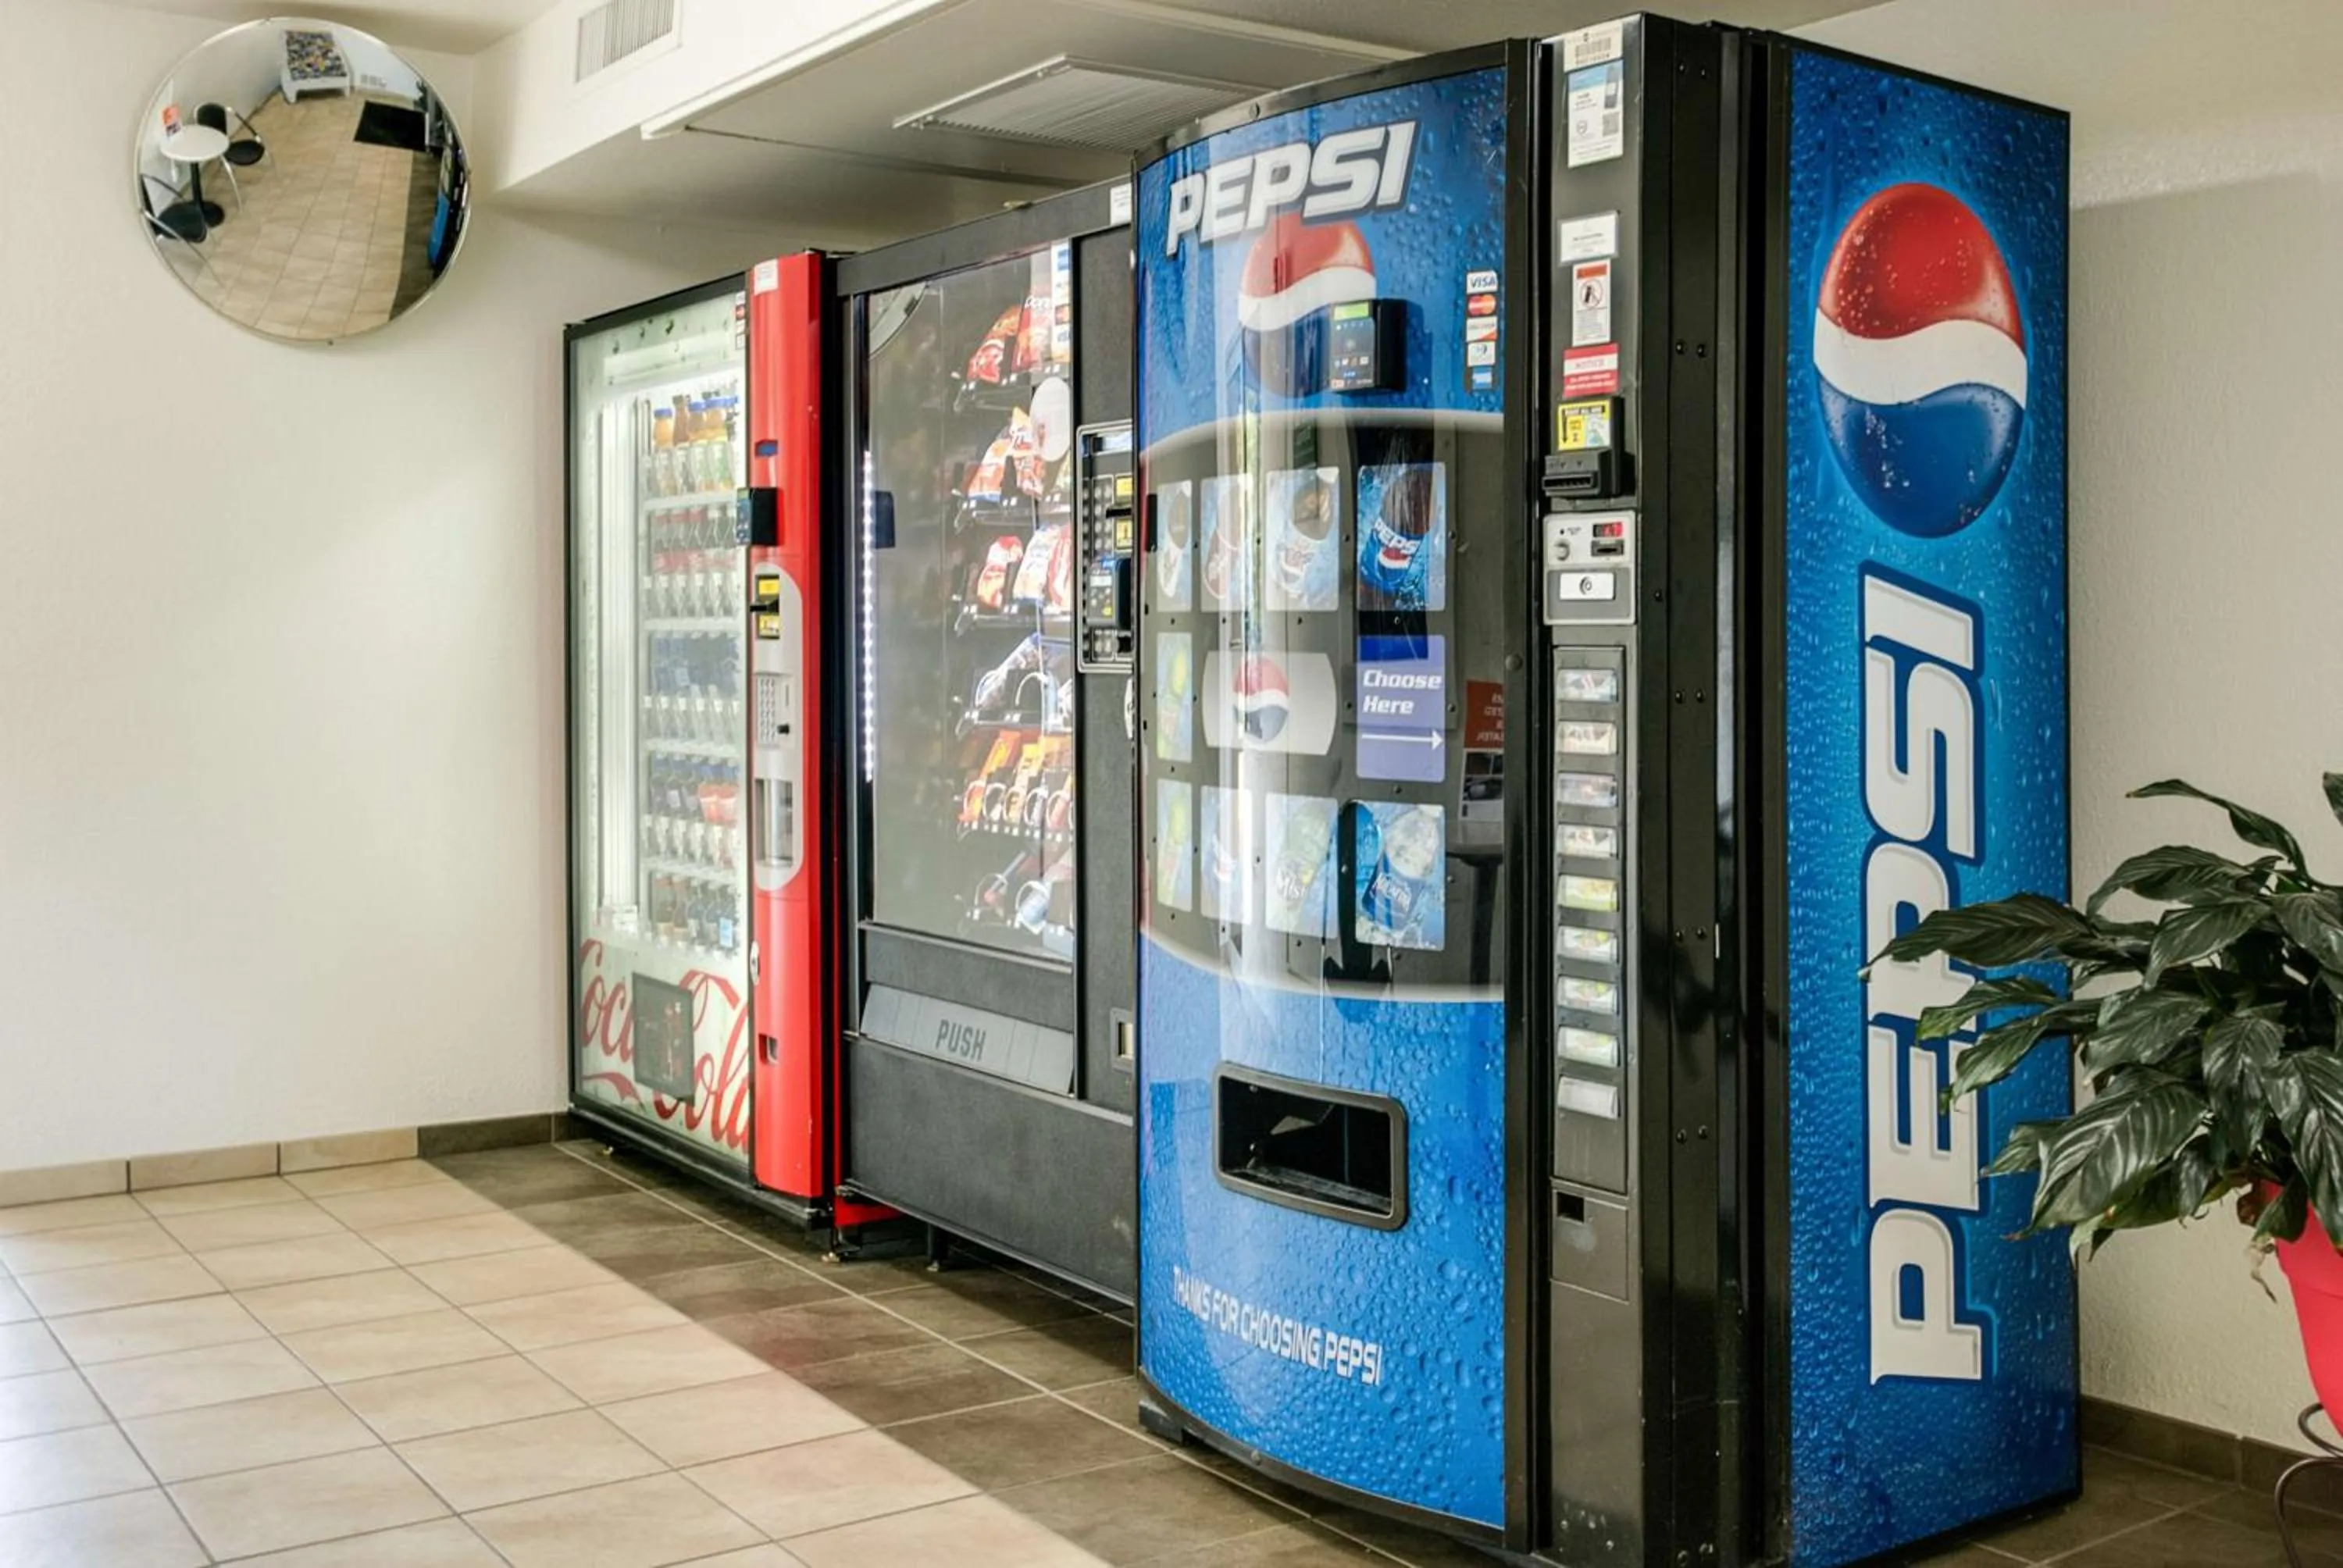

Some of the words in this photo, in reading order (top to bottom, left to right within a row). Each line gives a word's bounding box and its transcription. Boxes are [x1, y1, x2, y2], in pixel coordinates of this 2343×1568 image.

[1165, 120, 1417, 257] PEPSI
[1471, 276, 1496, 288] VISA
[1375, 517, 1421, 554] PEPS
[1362, 669, 1443, 690] Choose
[1362, 695, 1414, 715] Here
[1863, 573, 1982, 1384] PEPSI
[935, 1019, 986, 1061] PUSH
[1173, 1264, 1212, 1322] THANKS
[1212, 1288, 1240, 1335] FOR
[1240, 1303, 1322, 1369] CHOOSING
[1324, 1331, 1383, 1386] PEPSI
